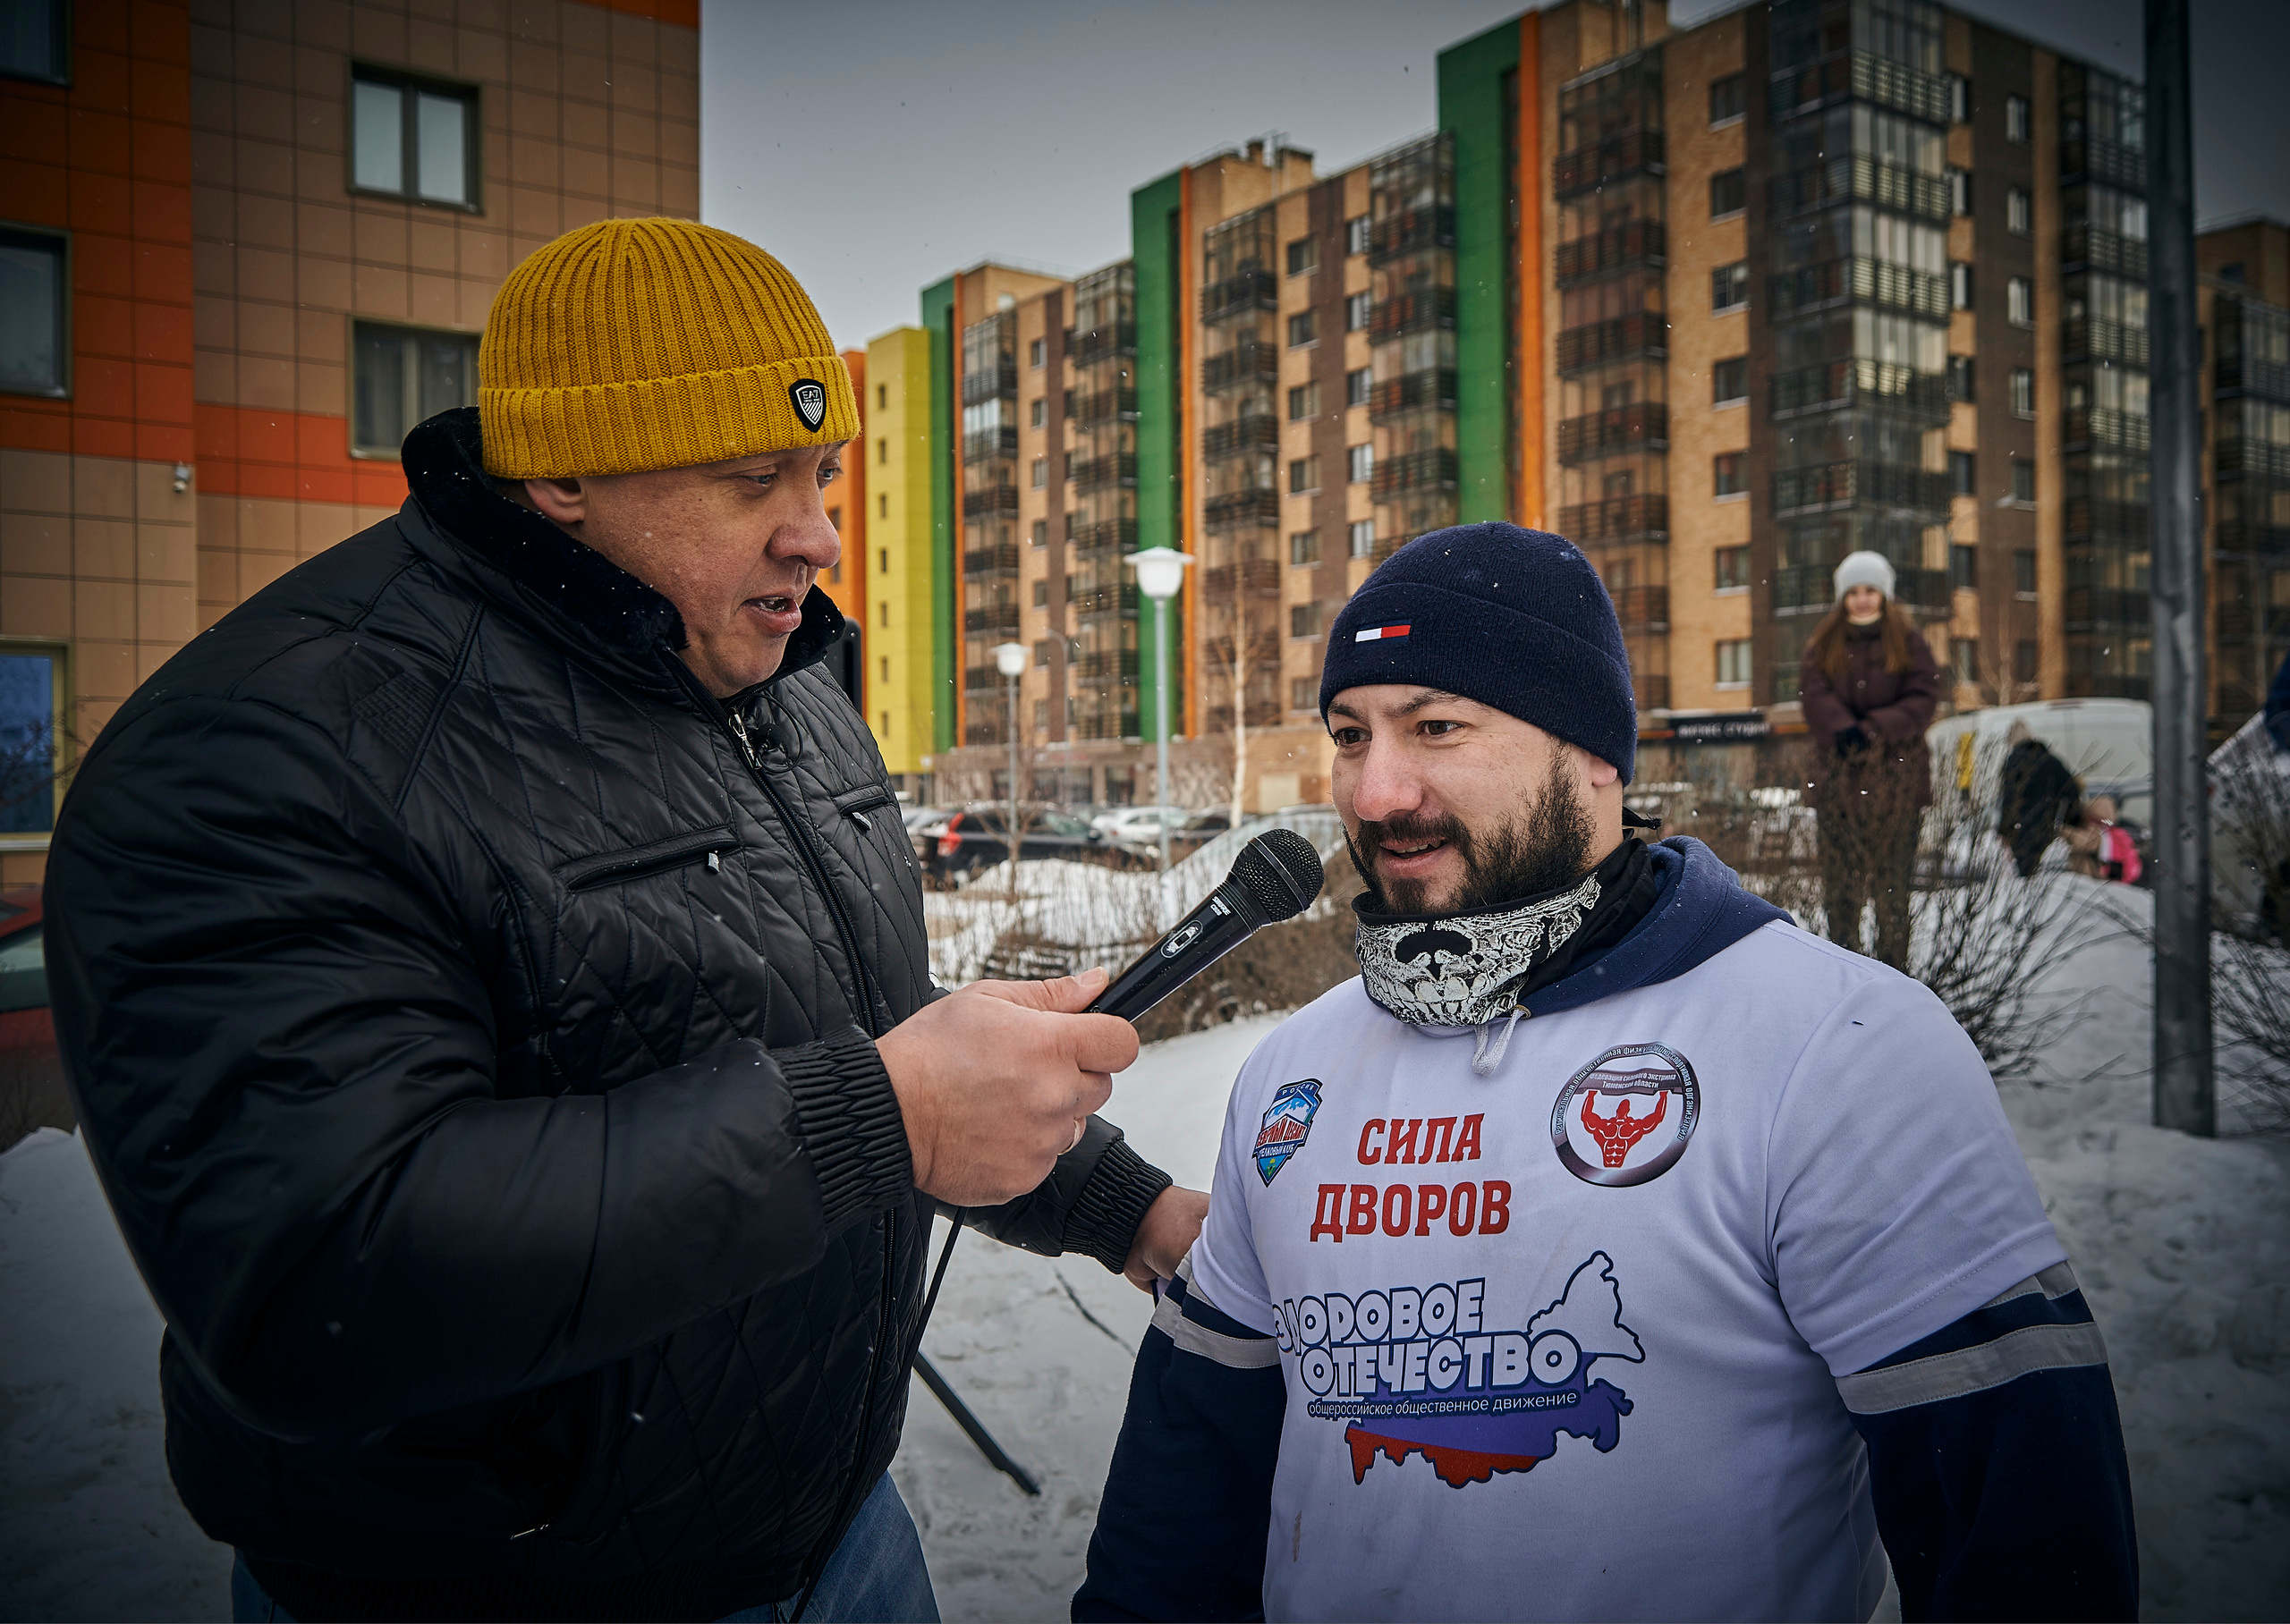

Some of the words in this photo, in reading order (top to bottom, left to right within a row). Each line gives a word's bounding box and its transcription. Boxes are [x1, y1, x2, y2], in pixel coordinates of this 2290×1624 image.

[802, 389, 819, 400] EA7
[1211, 895, 1232, 916] SHURE
[1357, 1112, 1486, 1166] СИЛА
[1310, 1180, 1513, 1243] ДВОРОВ
[1300, 1329, 1583, 1397] ОТЕЧЕСТВО
[1309, 1399, 1393, 1418] общероссийское
[1395, 1398, 1488, 1416] общественное
[1492, 1391, 1577, 1412] движение
